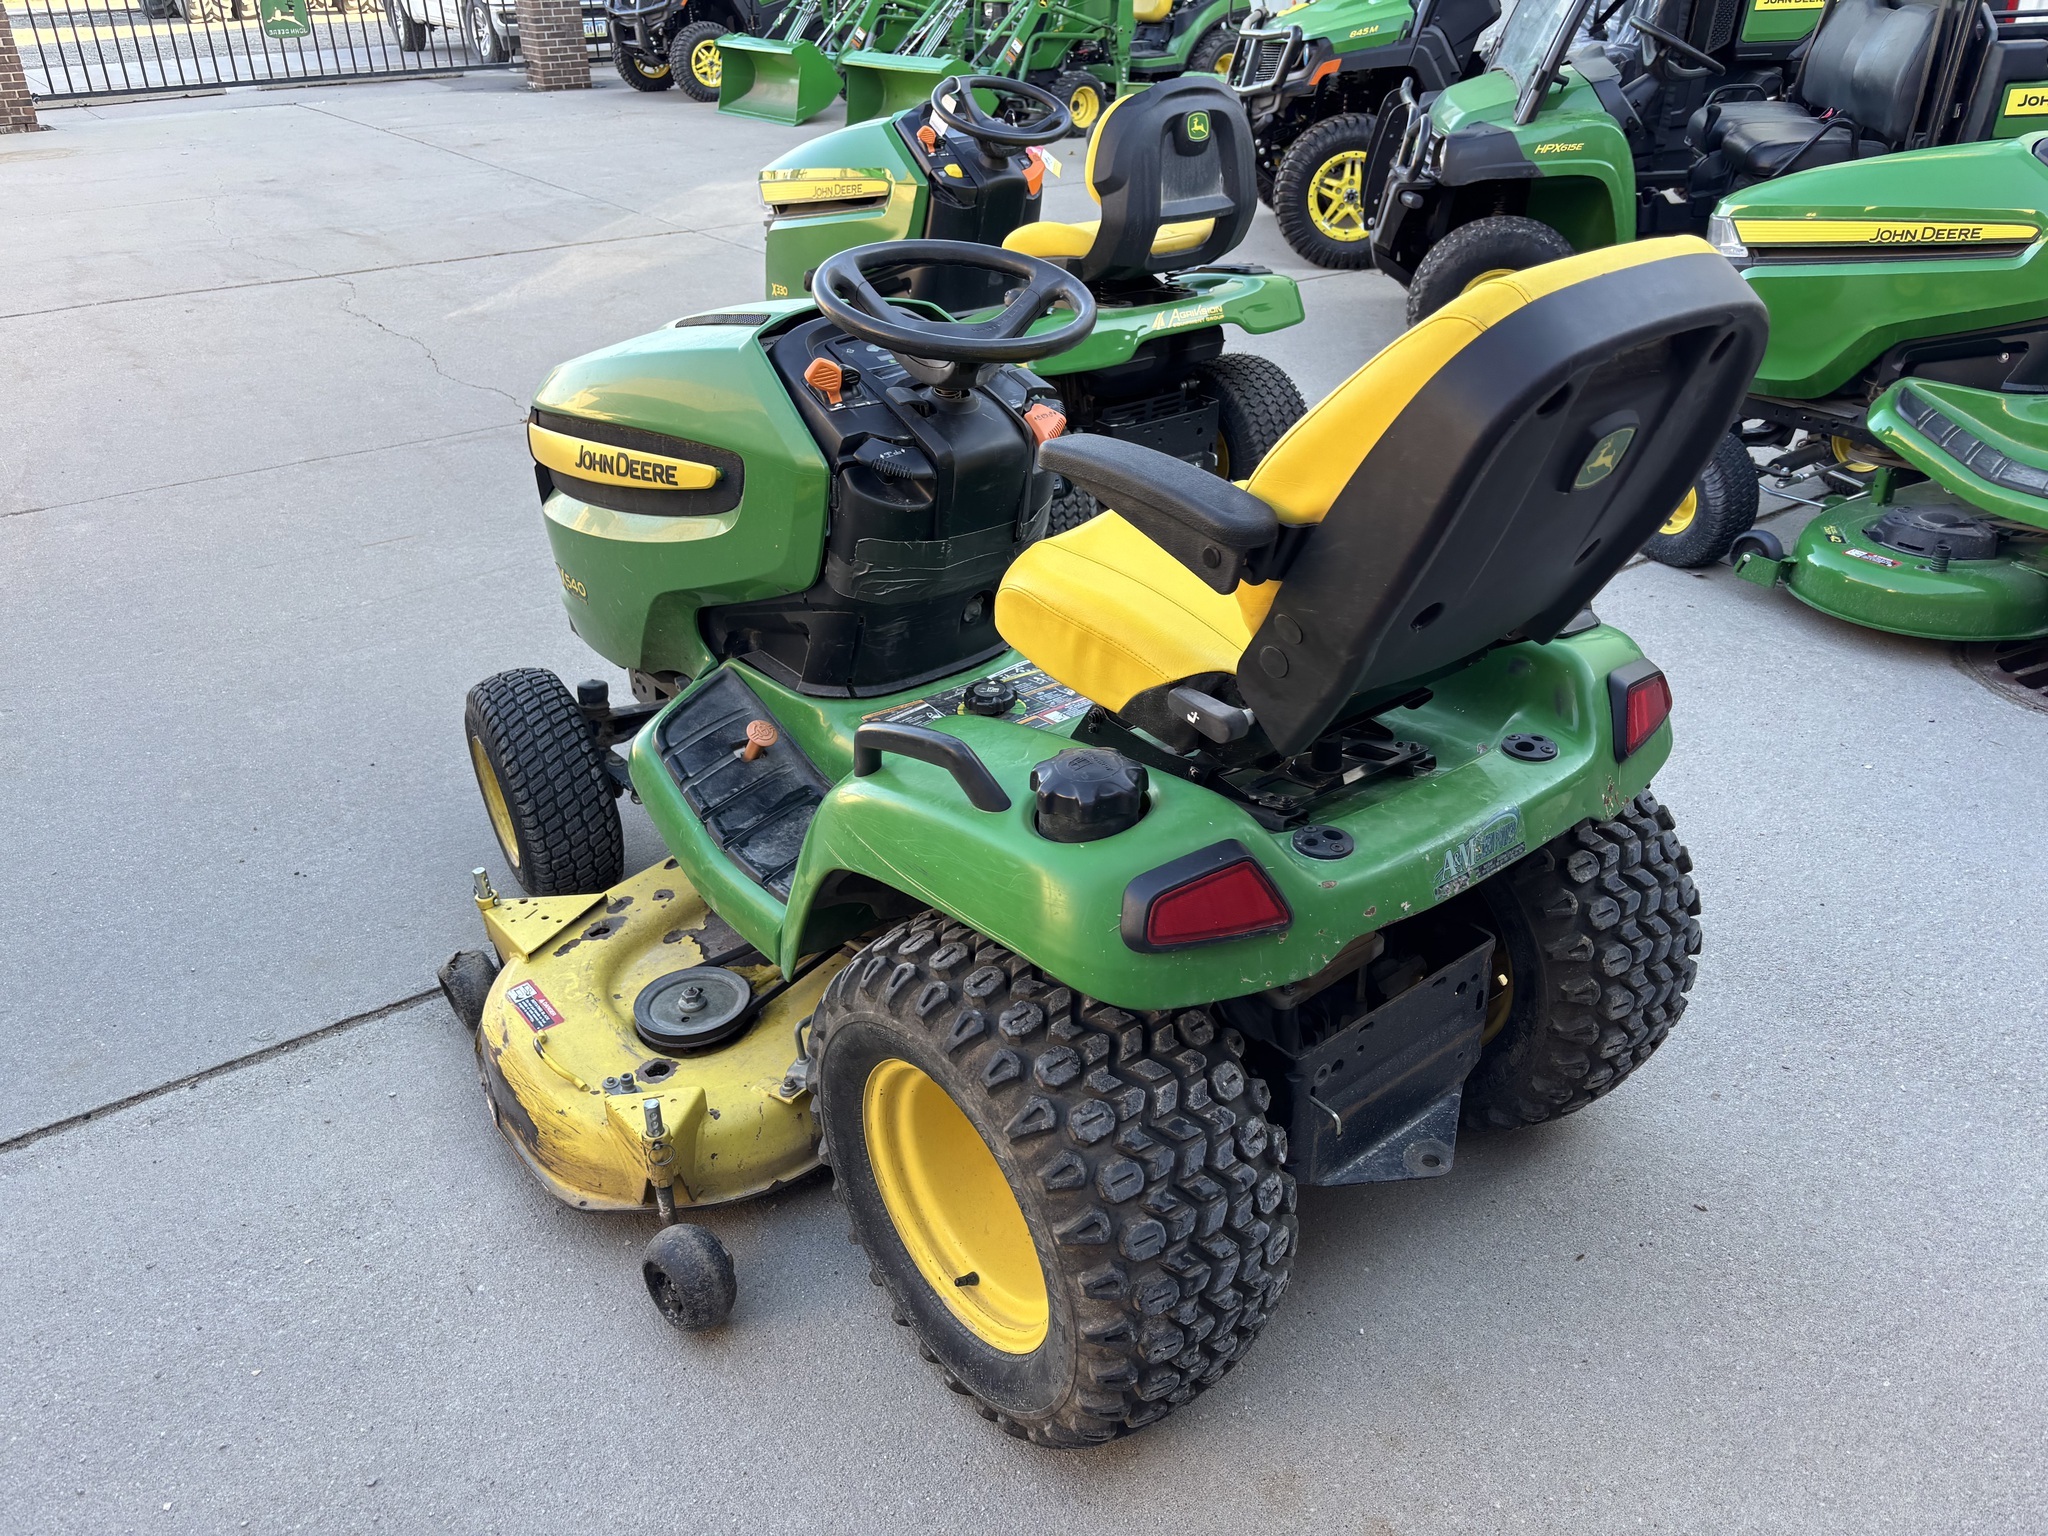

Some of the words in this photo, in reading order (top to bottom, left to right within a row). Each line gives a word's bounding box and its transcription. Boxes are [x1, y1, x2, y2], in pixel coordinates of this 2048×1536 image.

[812, 185, 834, 199] JOHN
[834, 183, 863, 195] DEERE
[1869, 227, 1918, 241] JOHN
[1920, 226, 1983, 240] DEERE
[574, 444, 615, 475] JOHN
[615, 451, 679, 487] DEERE
